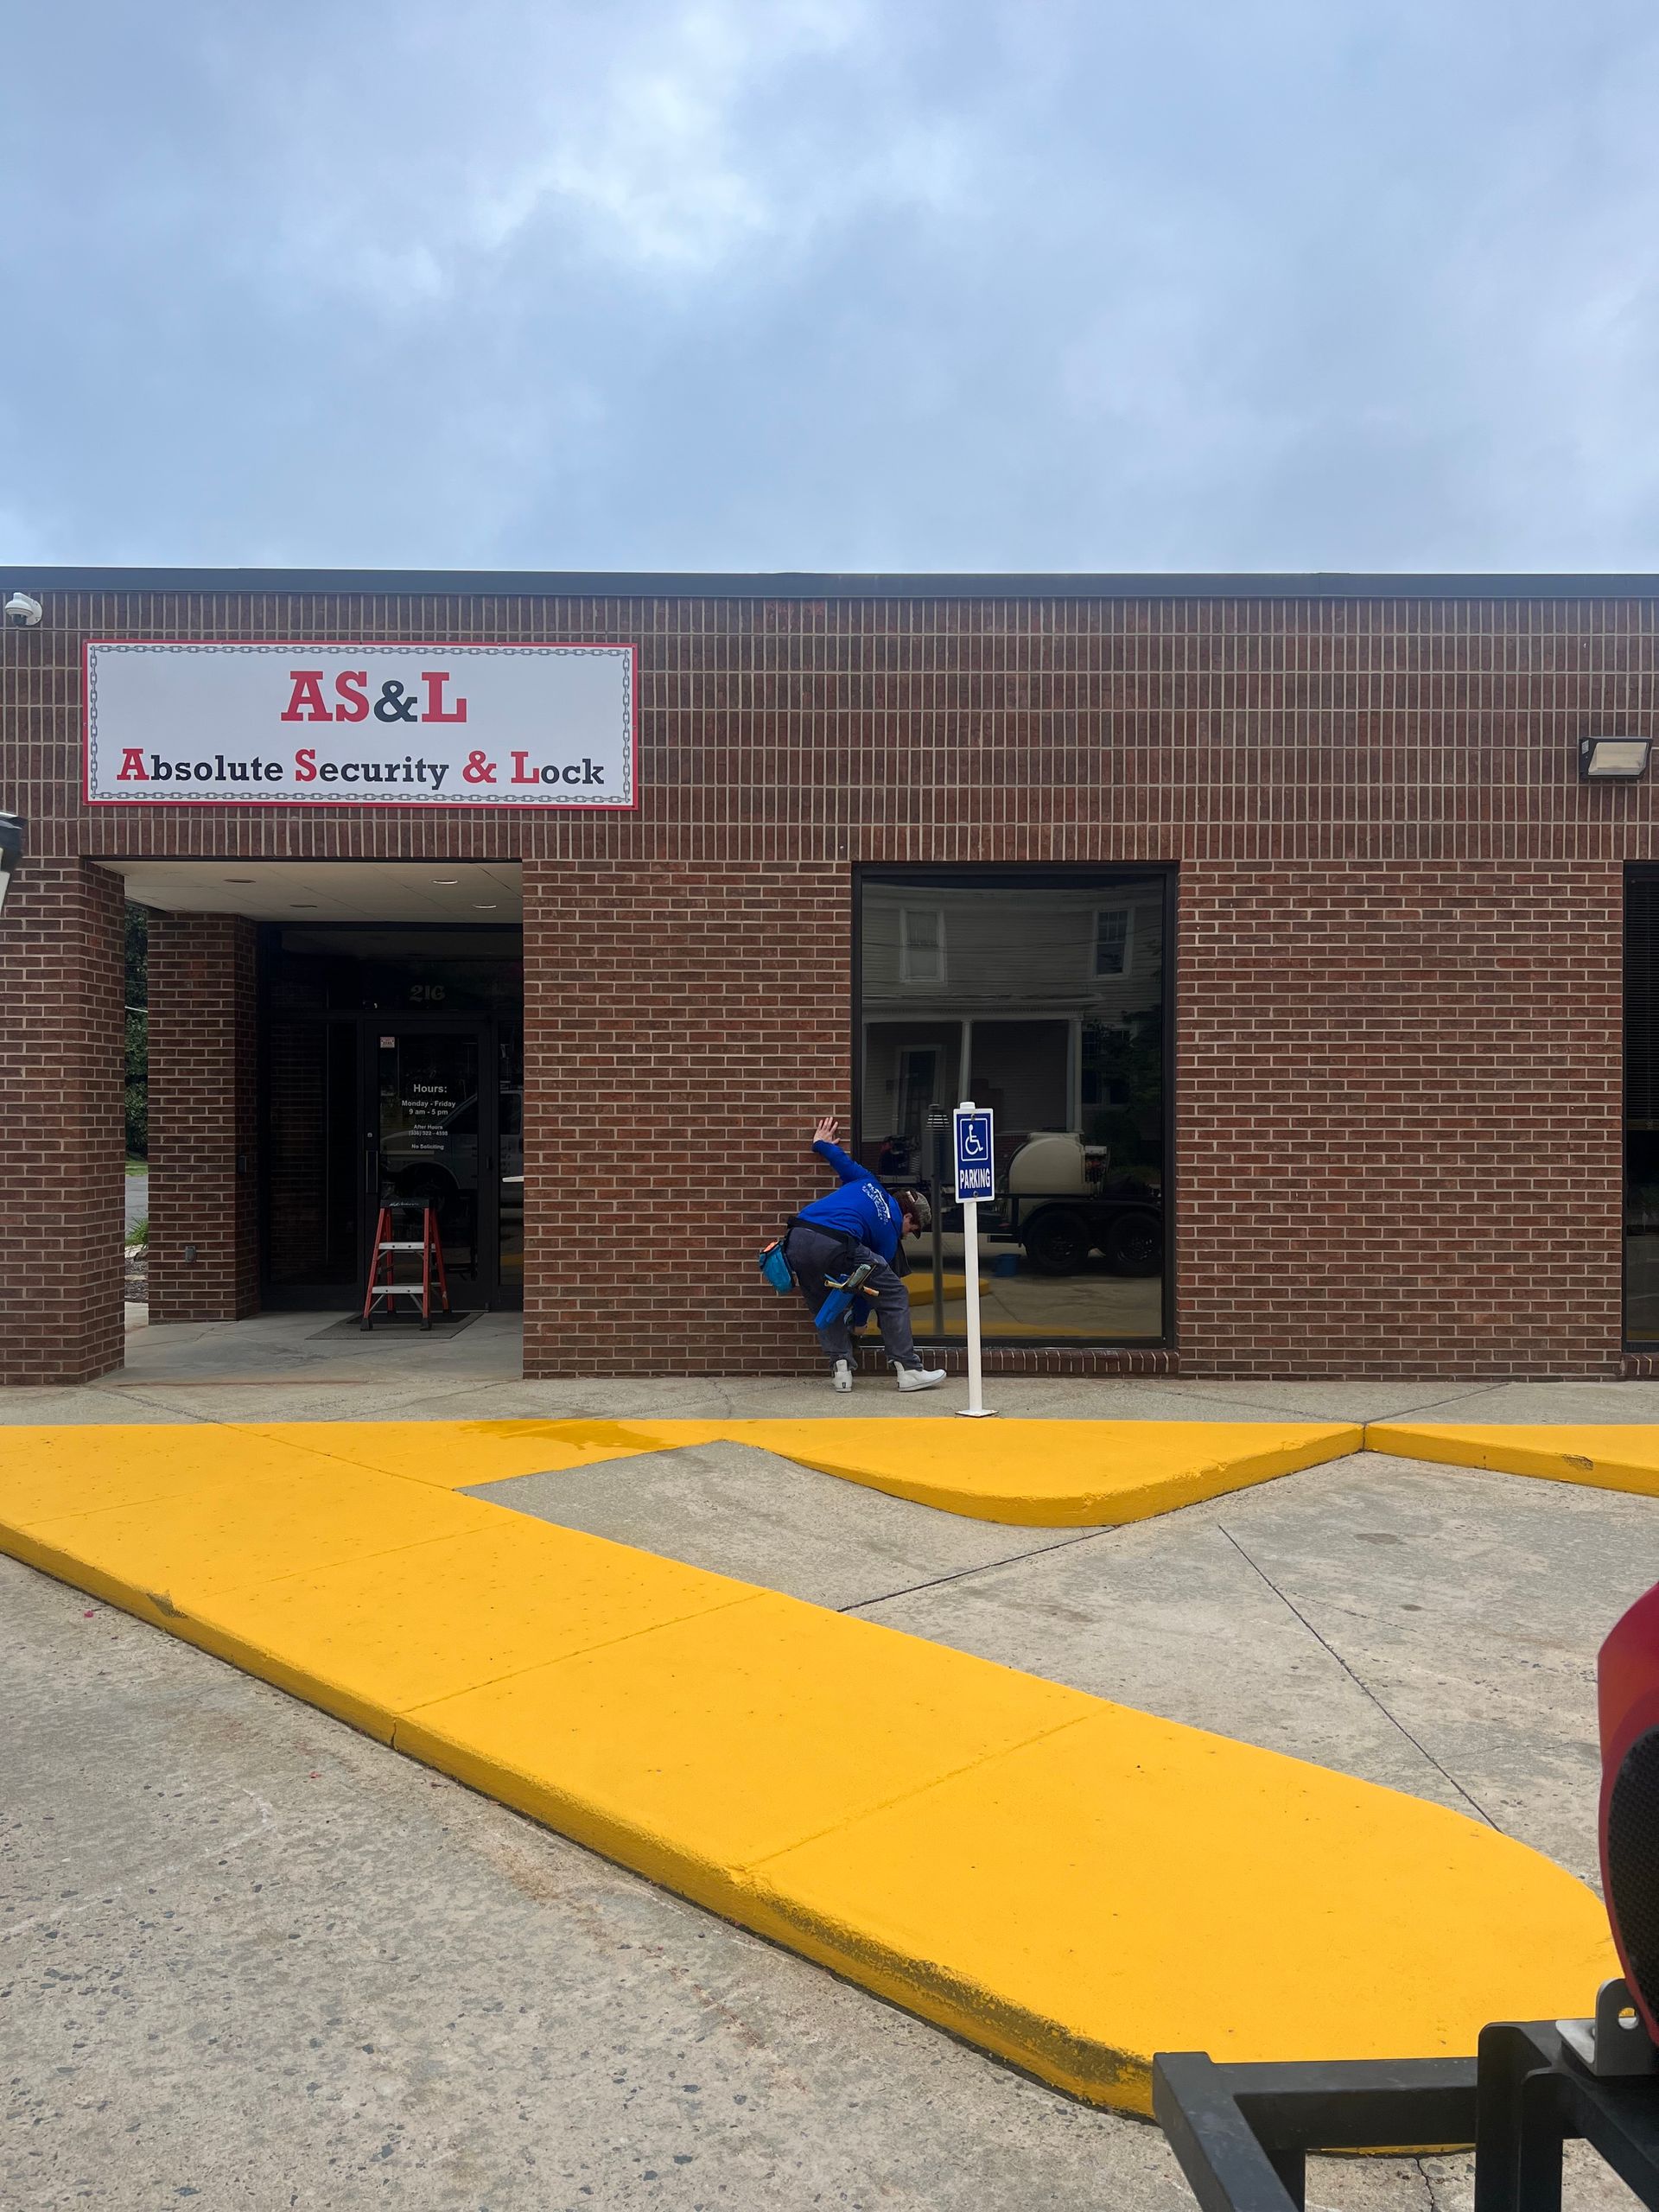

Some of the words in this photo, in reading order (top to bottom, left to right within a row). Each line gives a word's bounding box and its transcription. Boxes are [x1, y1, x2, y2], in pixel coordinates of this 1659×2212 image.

[281, 671, 467, 723] AS&L
[117, 748, 283, 782] Absolute
[296, 749, 449, 791] Security
[462, 751, 497, 784] &
[511, 752, 605, 785] Lock
[413, 1084, 447, 1093] Hours:
[959, 1168, 991, 1189] PARKING
